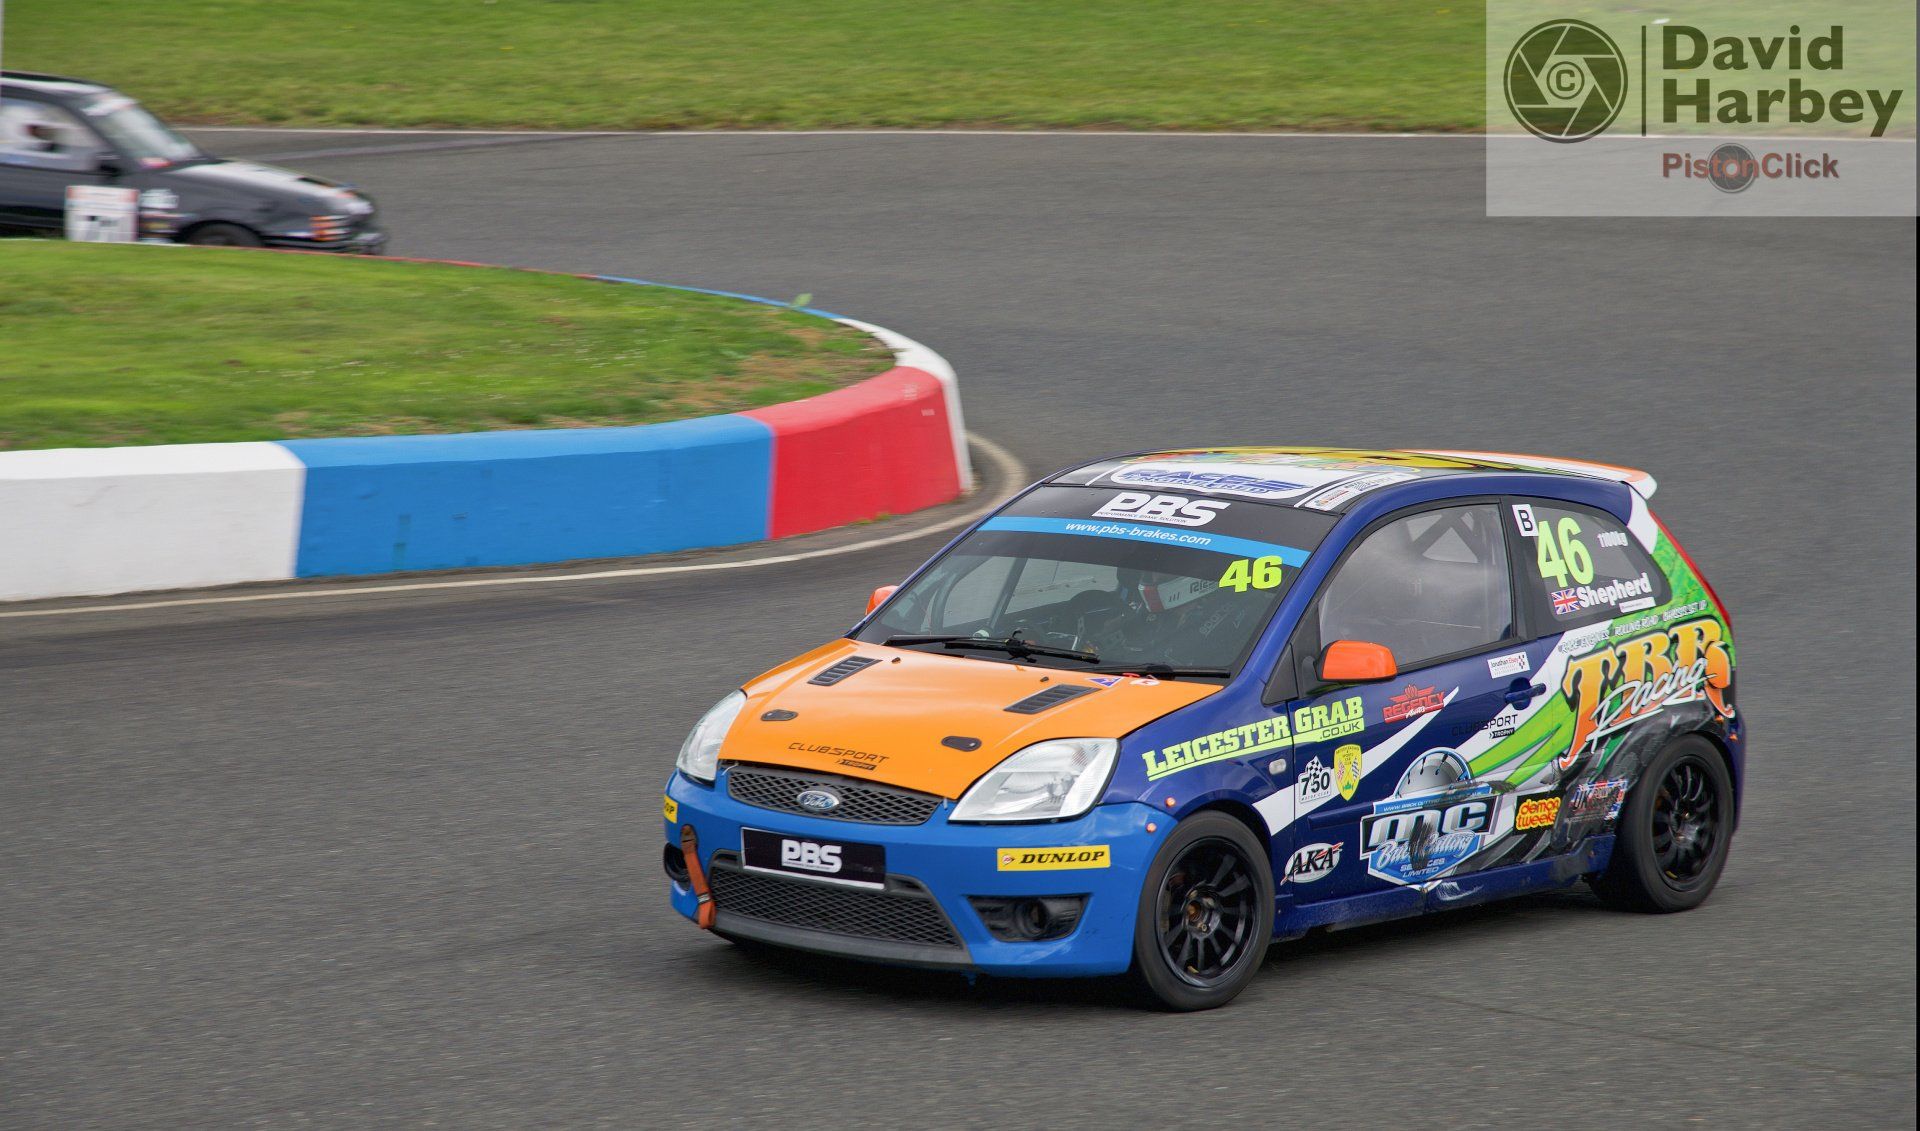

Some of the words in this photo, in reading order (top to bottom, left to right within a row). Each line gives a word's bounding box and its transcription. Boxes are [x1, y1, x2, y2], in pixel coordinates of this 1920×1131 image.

[1091, 491, 1232, 527] PBS
[1517, 509, 1534, 531] B
[1065, 523, 1212, 545] www.pbs-brakes.com
[1537, 517, 1594, 588] 46
[1218, 555, 1283, 593] 46
[1576, 572, 1653, 608] Shepherd
[1383, 691, 1445, 719] REGENCY
[1586, 657, 1718, 753] Racing
[1142, 715, 1292, 776] LEICESTER
[1294, 696, 1364, 733] GRAB
[1319, 721, 1361, 740] .CO.UK
[1451, 713, 1519, 736] CLUBSPORT
[1494, 728, 1514, 738] TROPHY
[788, 742, 890, 764] CLUBSPORT
[1300, 771, 1331, 796] 750
[803, 793, 834, 807] Ford
[781, 838, 843, 874] PBS
[1019, 851, 1106, 864] DUNLOP
[1286, 846, 1335, 877] AKA
[1402, 866, 1440, 878] LIMITED
